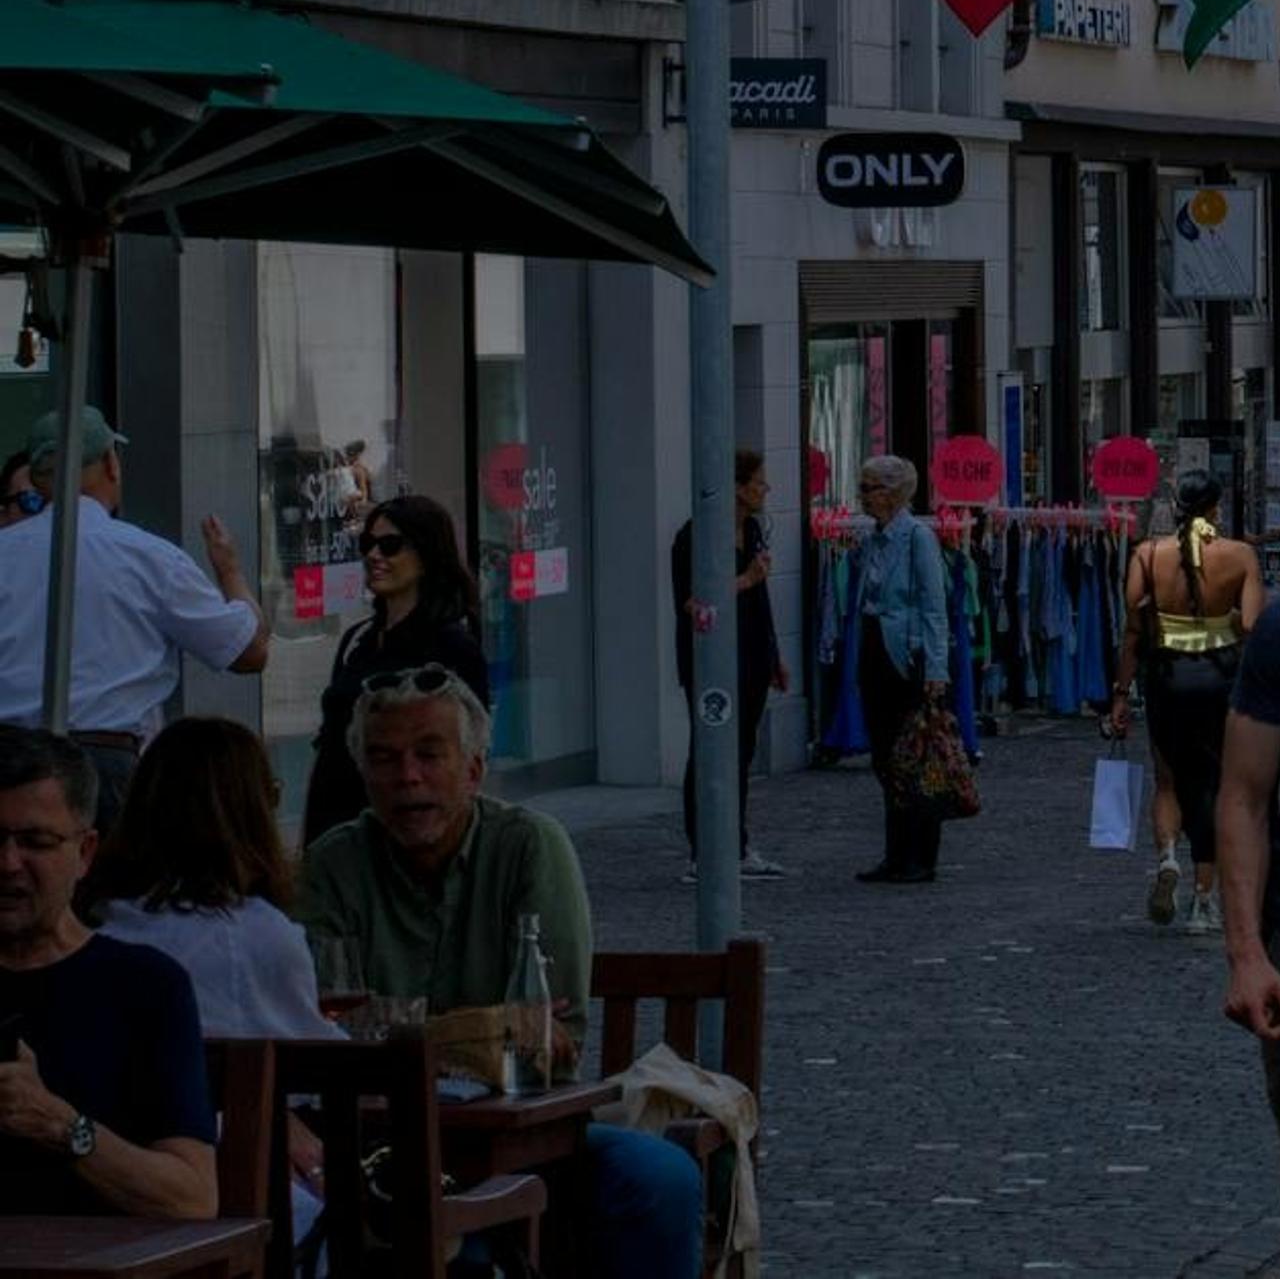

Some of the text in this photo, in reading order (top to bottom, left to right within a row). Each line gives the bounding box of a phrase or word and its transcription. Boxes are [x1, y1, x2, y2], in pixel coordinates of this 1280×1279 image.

[730, 75, 817, 104] acadi
[732, 107, 797, 122] PARIS
[824, 152, 955, 188] ONLY
[522, 446, 557, 510] sale
[942, 460, 993, 481] 15 CHF
